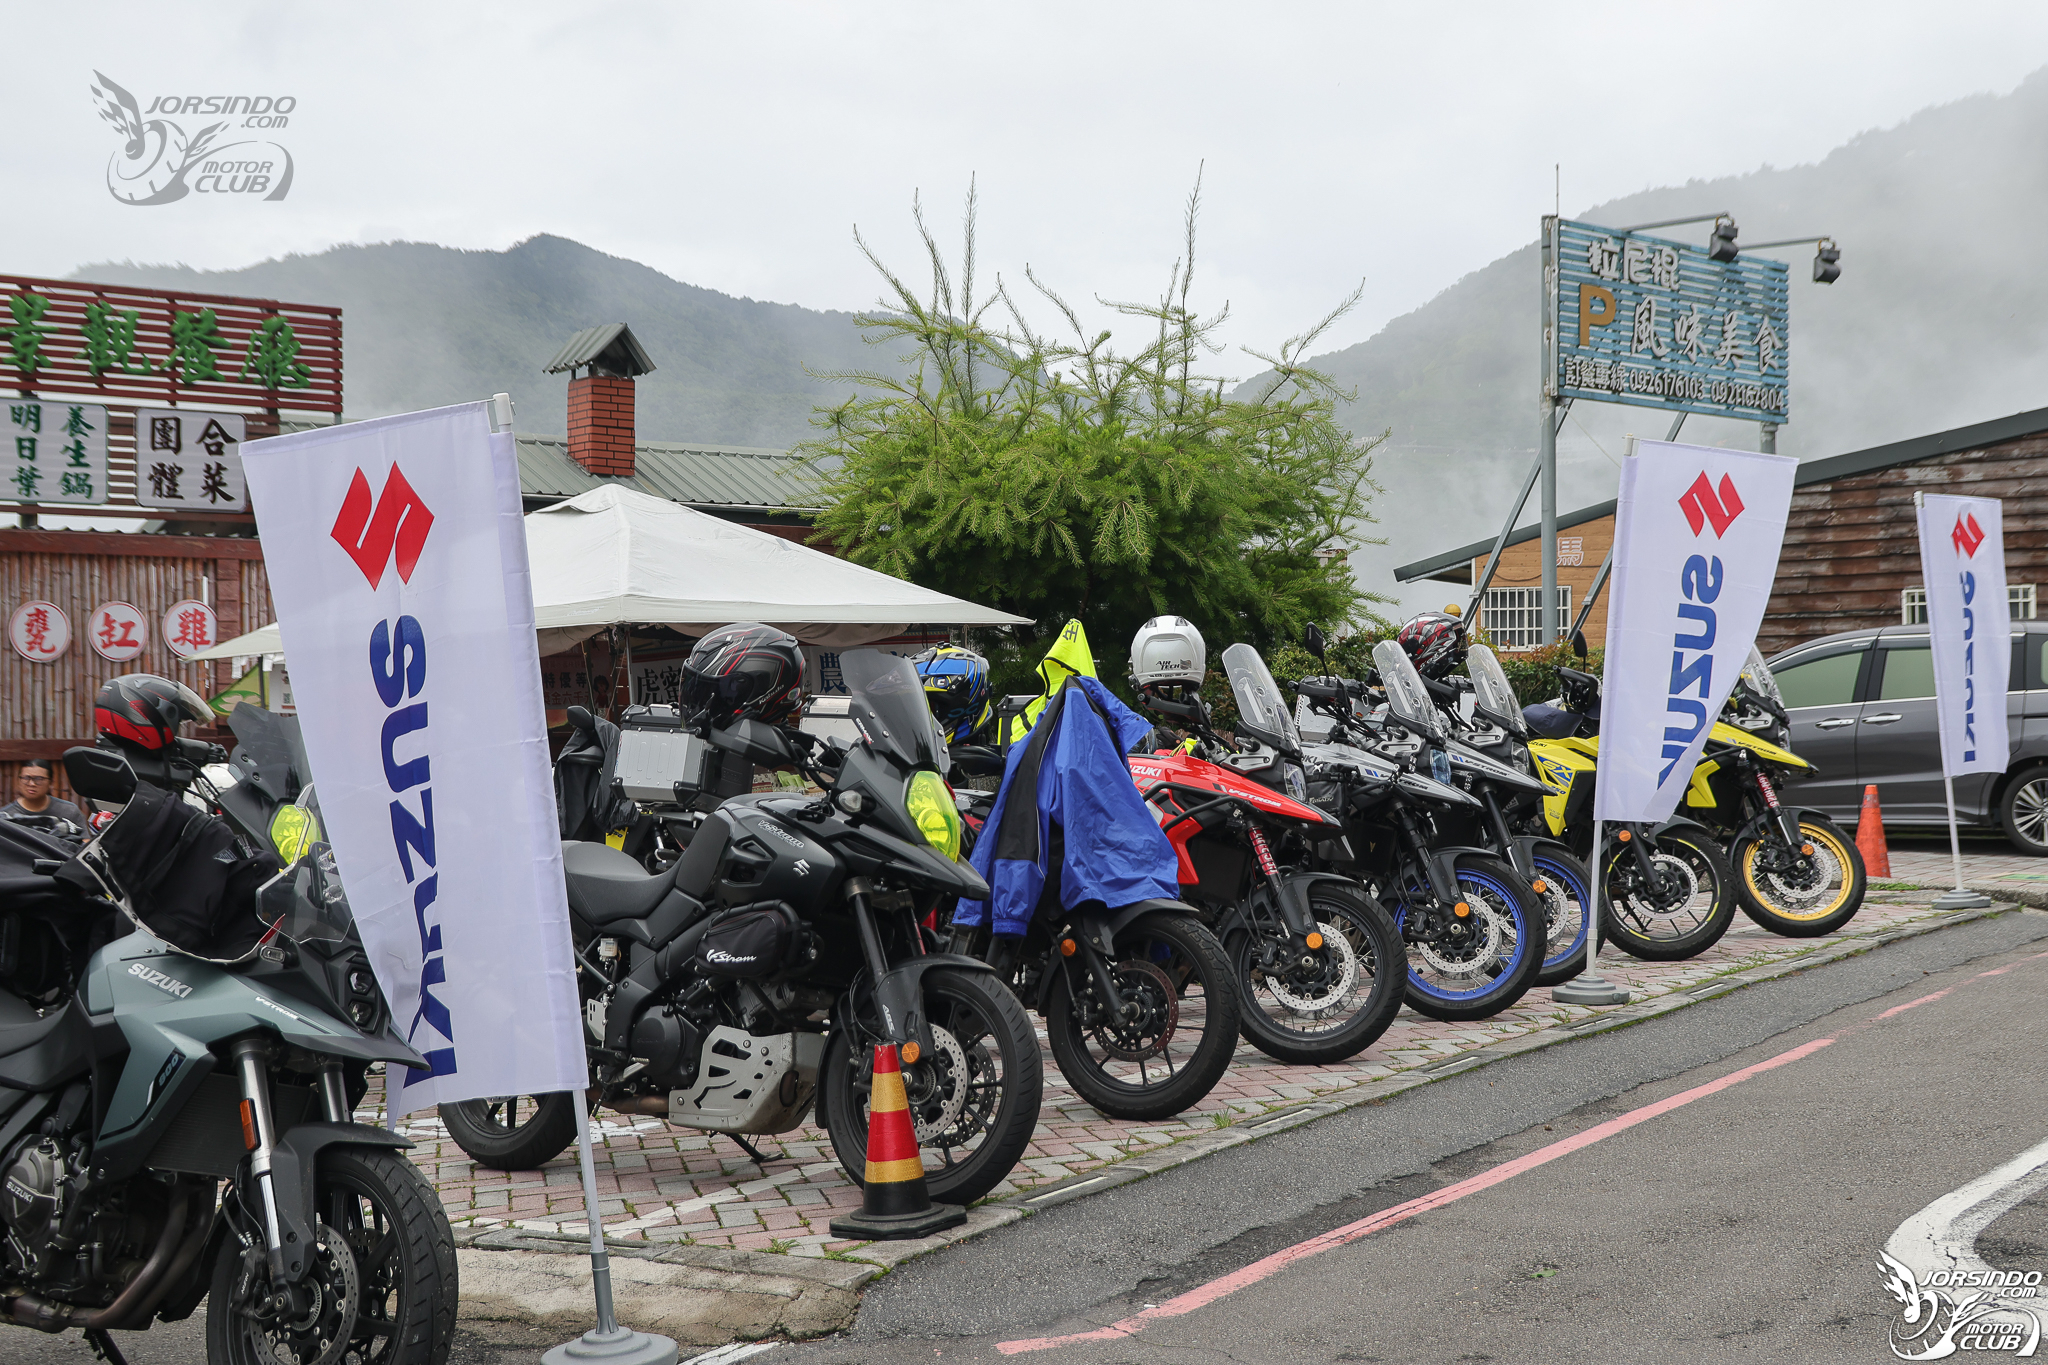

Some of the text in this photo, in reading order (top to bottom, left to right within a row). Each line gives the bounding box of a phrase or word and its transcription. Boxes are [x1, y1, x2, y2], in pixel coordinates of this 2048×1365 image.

[1579, 283, 1617, 346] P
[1631, 296, 1783, 374] 風味美食
[1630, 368, 1706, 400] 0926176103
[9, 403, 44, 497] 明日葉
[60, 406, 96, 500] 養生鍋
[147, 415, 185, 501] 團體
[195, 418, 239, 504] 合菜
[1129, 764, 1162, 777] UZUKI
[127, 962, 193, 999] SUZUKI
[5, 1180, 33, 1203] SUZUKI
